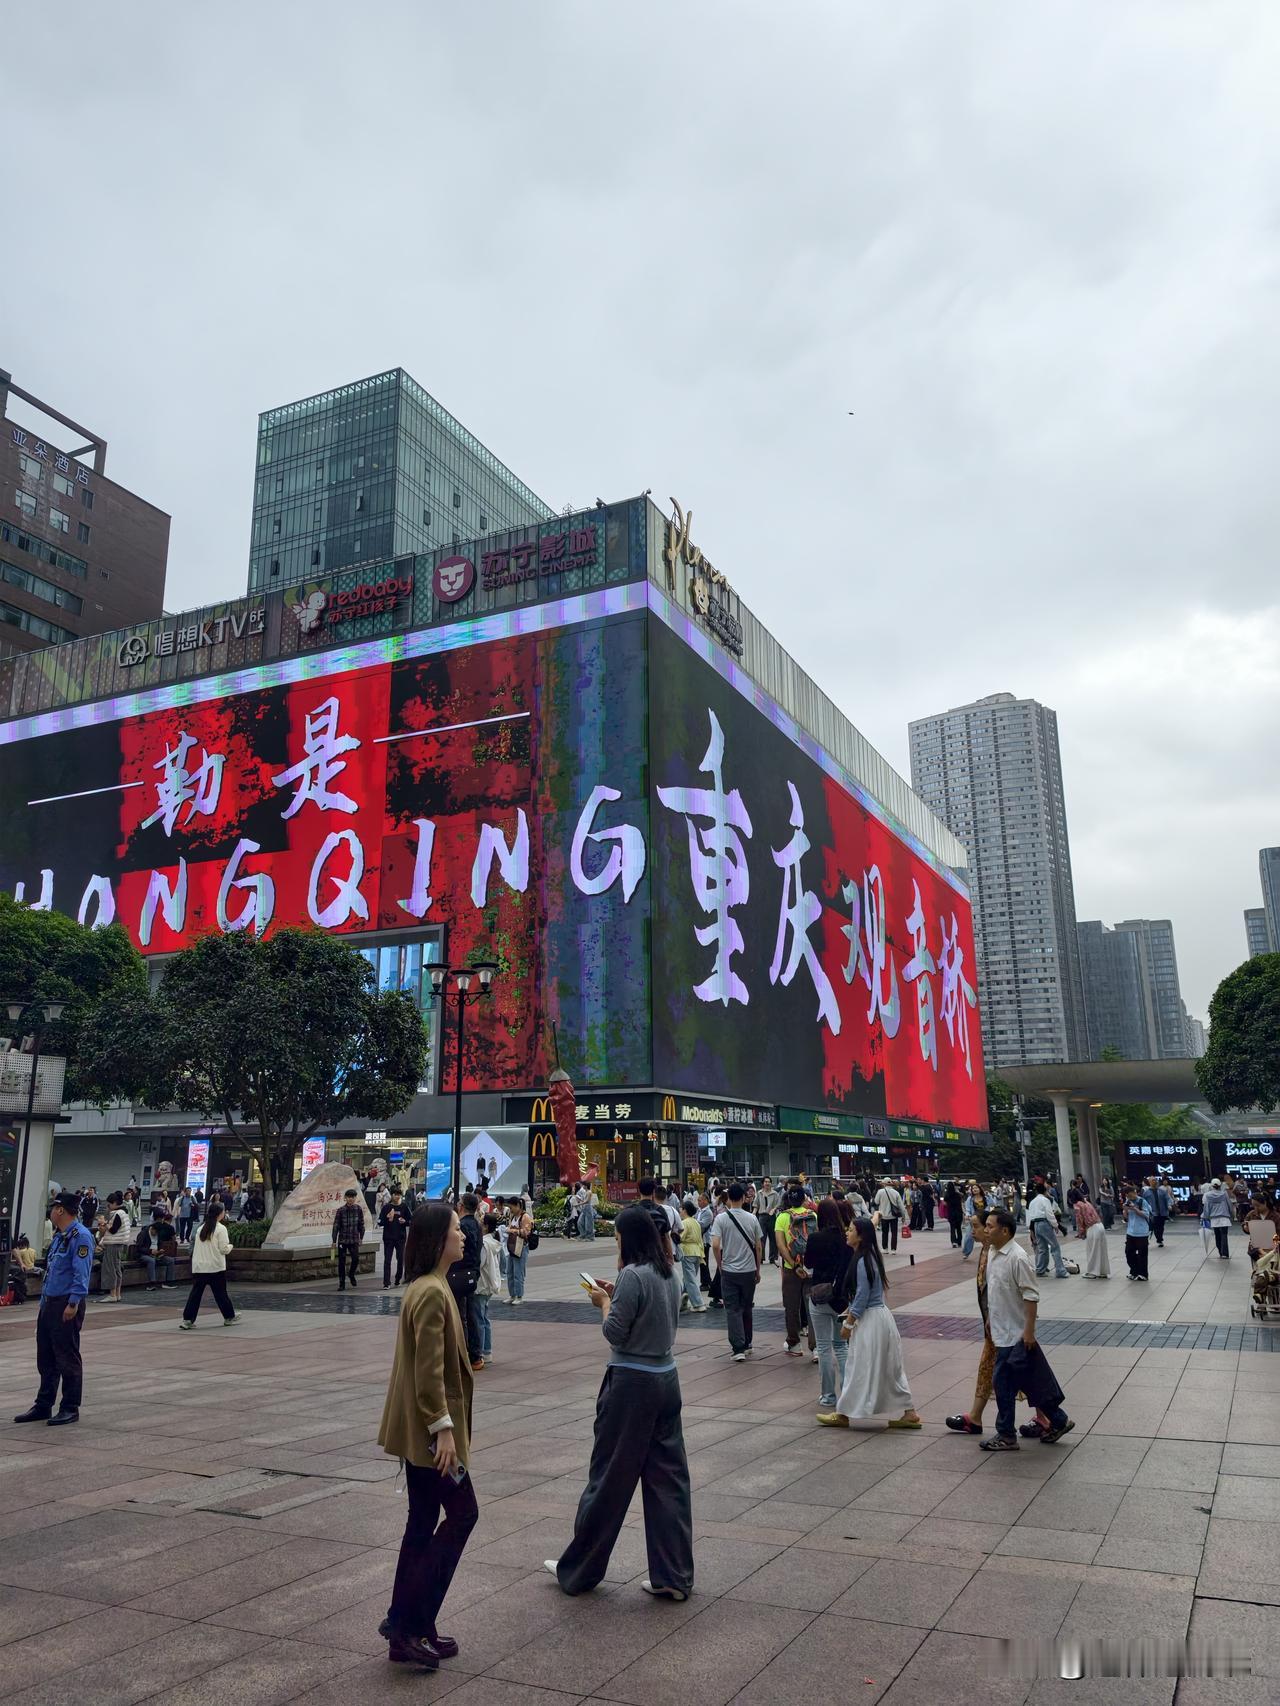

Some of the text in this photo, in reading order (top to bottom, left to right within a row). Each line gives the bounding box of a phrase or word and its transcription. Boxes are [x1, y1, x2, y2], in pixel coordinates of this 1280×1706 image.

[12, 428, 90, 485] 亚朵酒店
[481, 525, 597, 577] 苏宁影城
[481, 552, 596, 591] SUNING CINEMA
[328, 575, 413, 609] redbaby
[328, 595, 398, 623] 苏宁红孩子
[154, 608, 265, 656] 唱想KTV 6F
[575, 1104, 632, 1120] 麦当劳
[682, 1105, 724, 1123] McDonald's
[1225, 1142, 1259, 1156] Bravo
